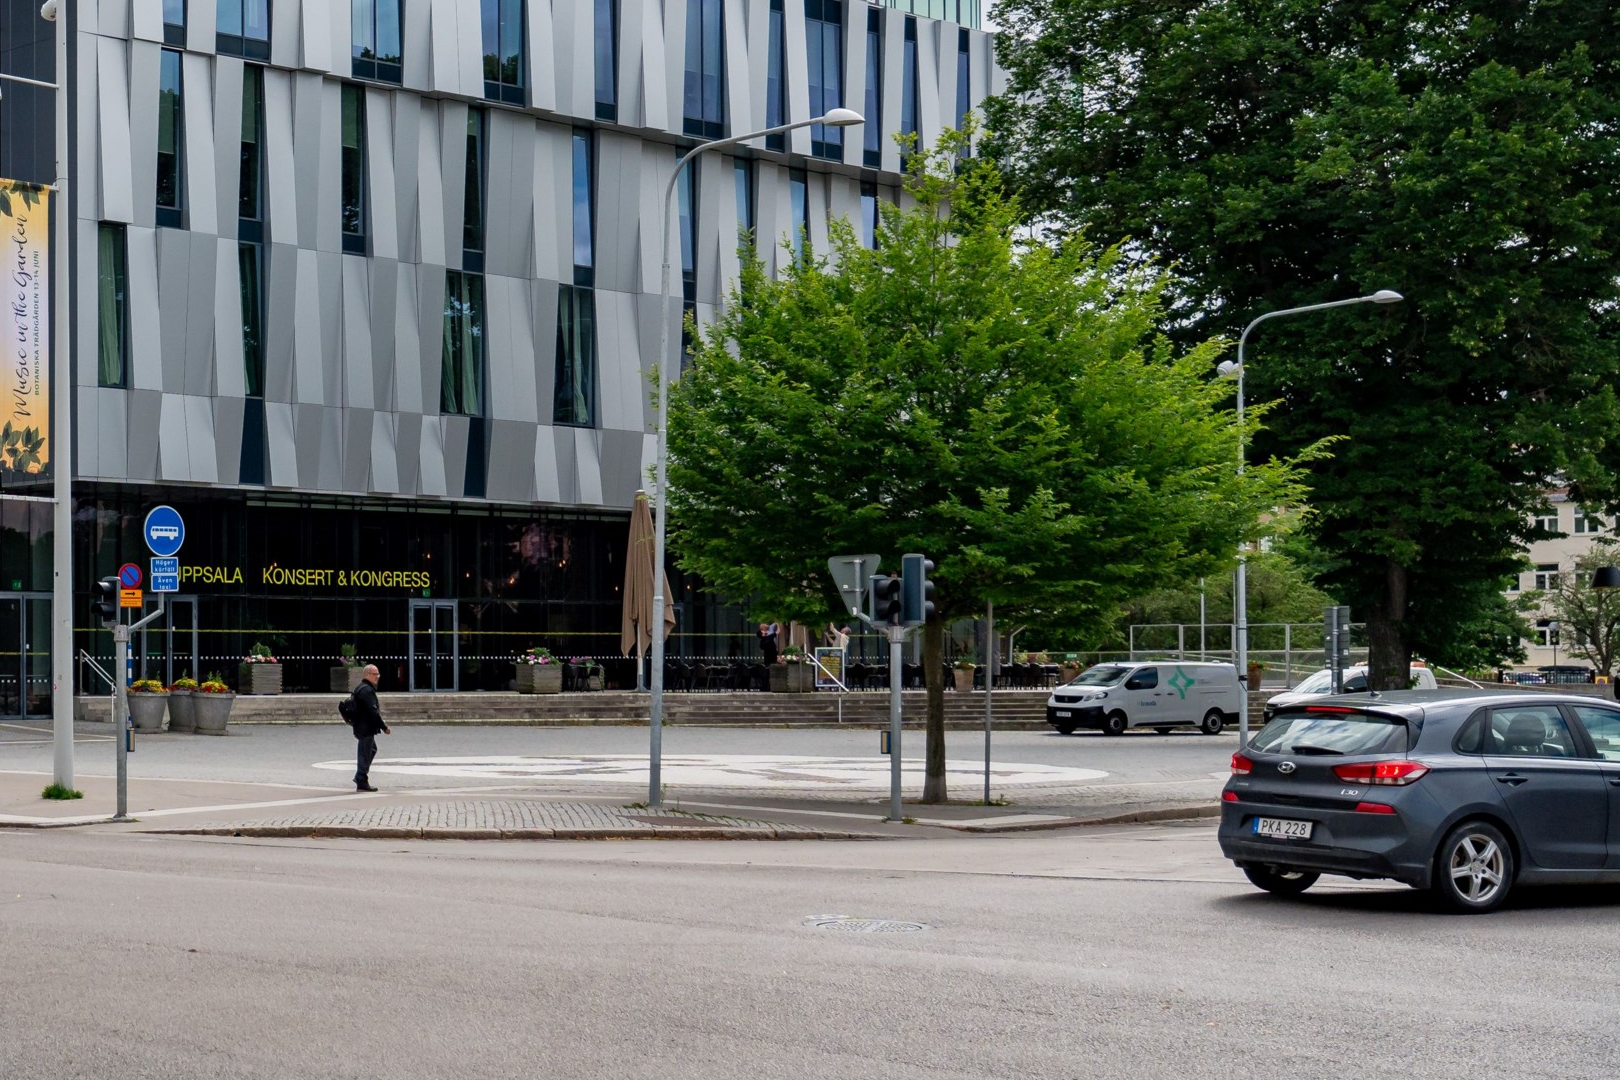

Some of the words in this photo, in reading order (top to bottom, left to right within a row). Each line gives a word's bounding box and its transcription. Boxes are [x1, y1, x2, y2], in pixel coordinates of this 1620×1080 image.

[12, 214, 32, 288] Garden
[16, 322, 28, 342] in
[13, 348, 32, 421] Music
[178, 566, 243, 583] PPSALA
[263, 568, 334, 586] KONSERT
[337, 570, 348, 586] &
[350, 570, 431, 588] KONGRESS
[1261, 820, 1281, 834] PKA
[1284, 822, 1306, 836] 228
